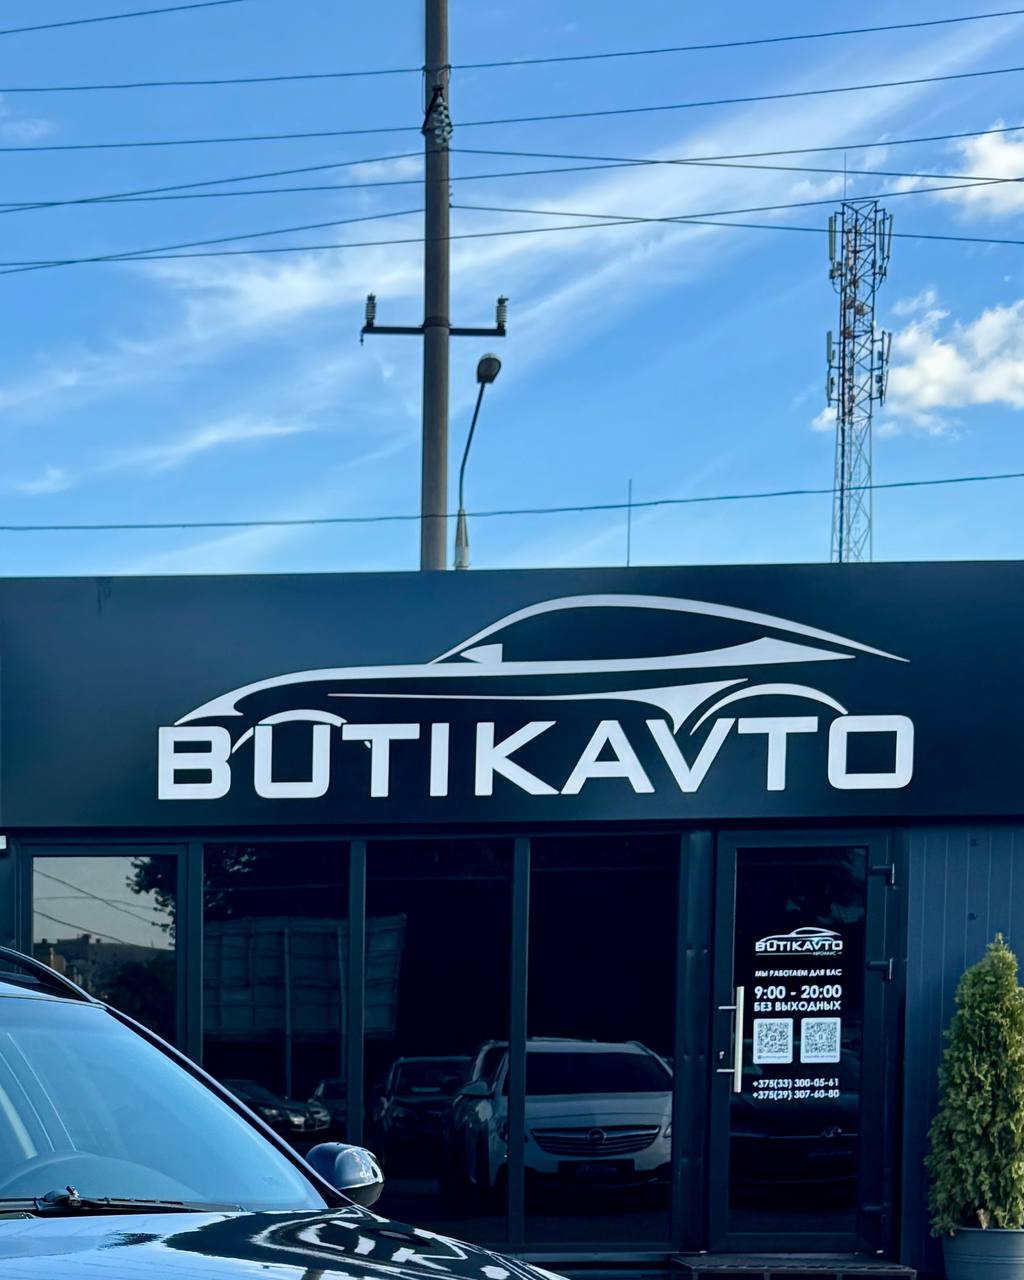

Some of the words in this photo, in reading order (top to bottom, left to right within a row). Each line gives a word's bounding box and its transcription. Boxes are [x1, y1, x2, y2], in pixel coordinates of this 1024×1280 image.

[157, 713, 915, 800] BUTIKAVTO
[755, 940, 843, 951] BUTIKAVTO
[770, 969, 808, 977] РАБОТАЕМ
[809, 969, 825, 977] ДЛЯ
[754, 985, 786, 999] 9:00
[800, 984, 843, 999] 20:00
[754, 1001, 772, 1012] БЕЗ
[774, 1000, 842, 1012] ВЫХОДНЫХ
[752, 1079, 792, 1089] +375(33)
[794, 1078, 839, 1087] 300-05-61
[752, 1090, 792, 1101] +375(29)
[793, 1089, 840, 1099] 307-60-80
